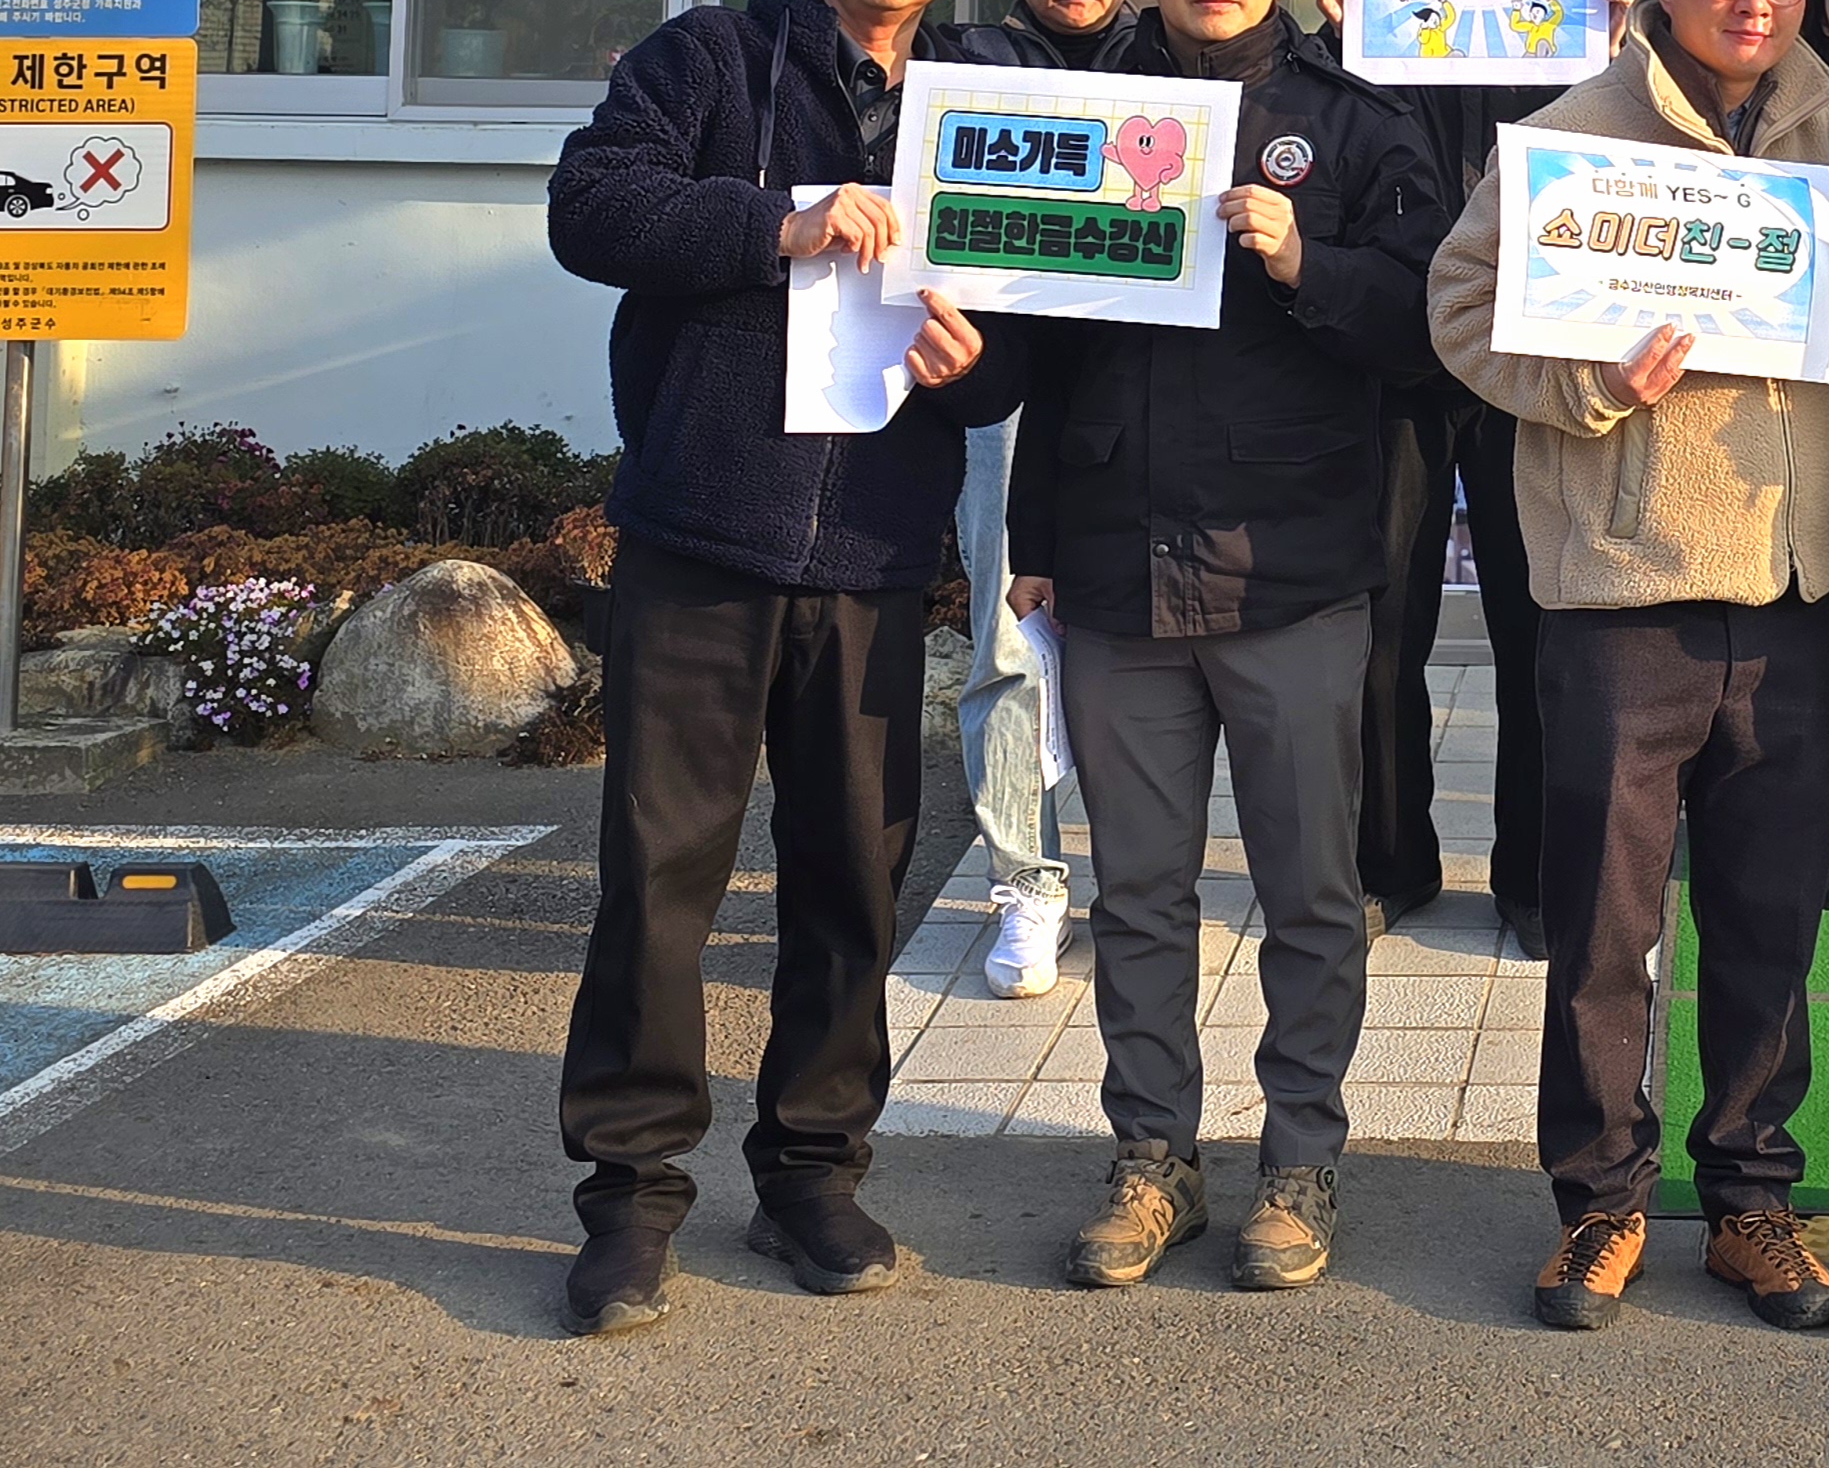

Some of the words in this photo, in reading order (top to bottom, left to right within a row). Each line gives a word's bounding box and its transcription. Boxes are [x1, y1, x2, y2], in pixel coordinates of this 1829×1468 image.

[10, 53, 168, 90] 제한구역
[83, 98, 136, 114] AREA)
[951, 125, 1090, 177] 미소가득
[1592, 177, 1659, 199] 다함께
[1737, 192, 1751, 208] G
[934, 206, 1178, 266] 친절한금수강산
[1, 317, 56, 330] 성주군수
